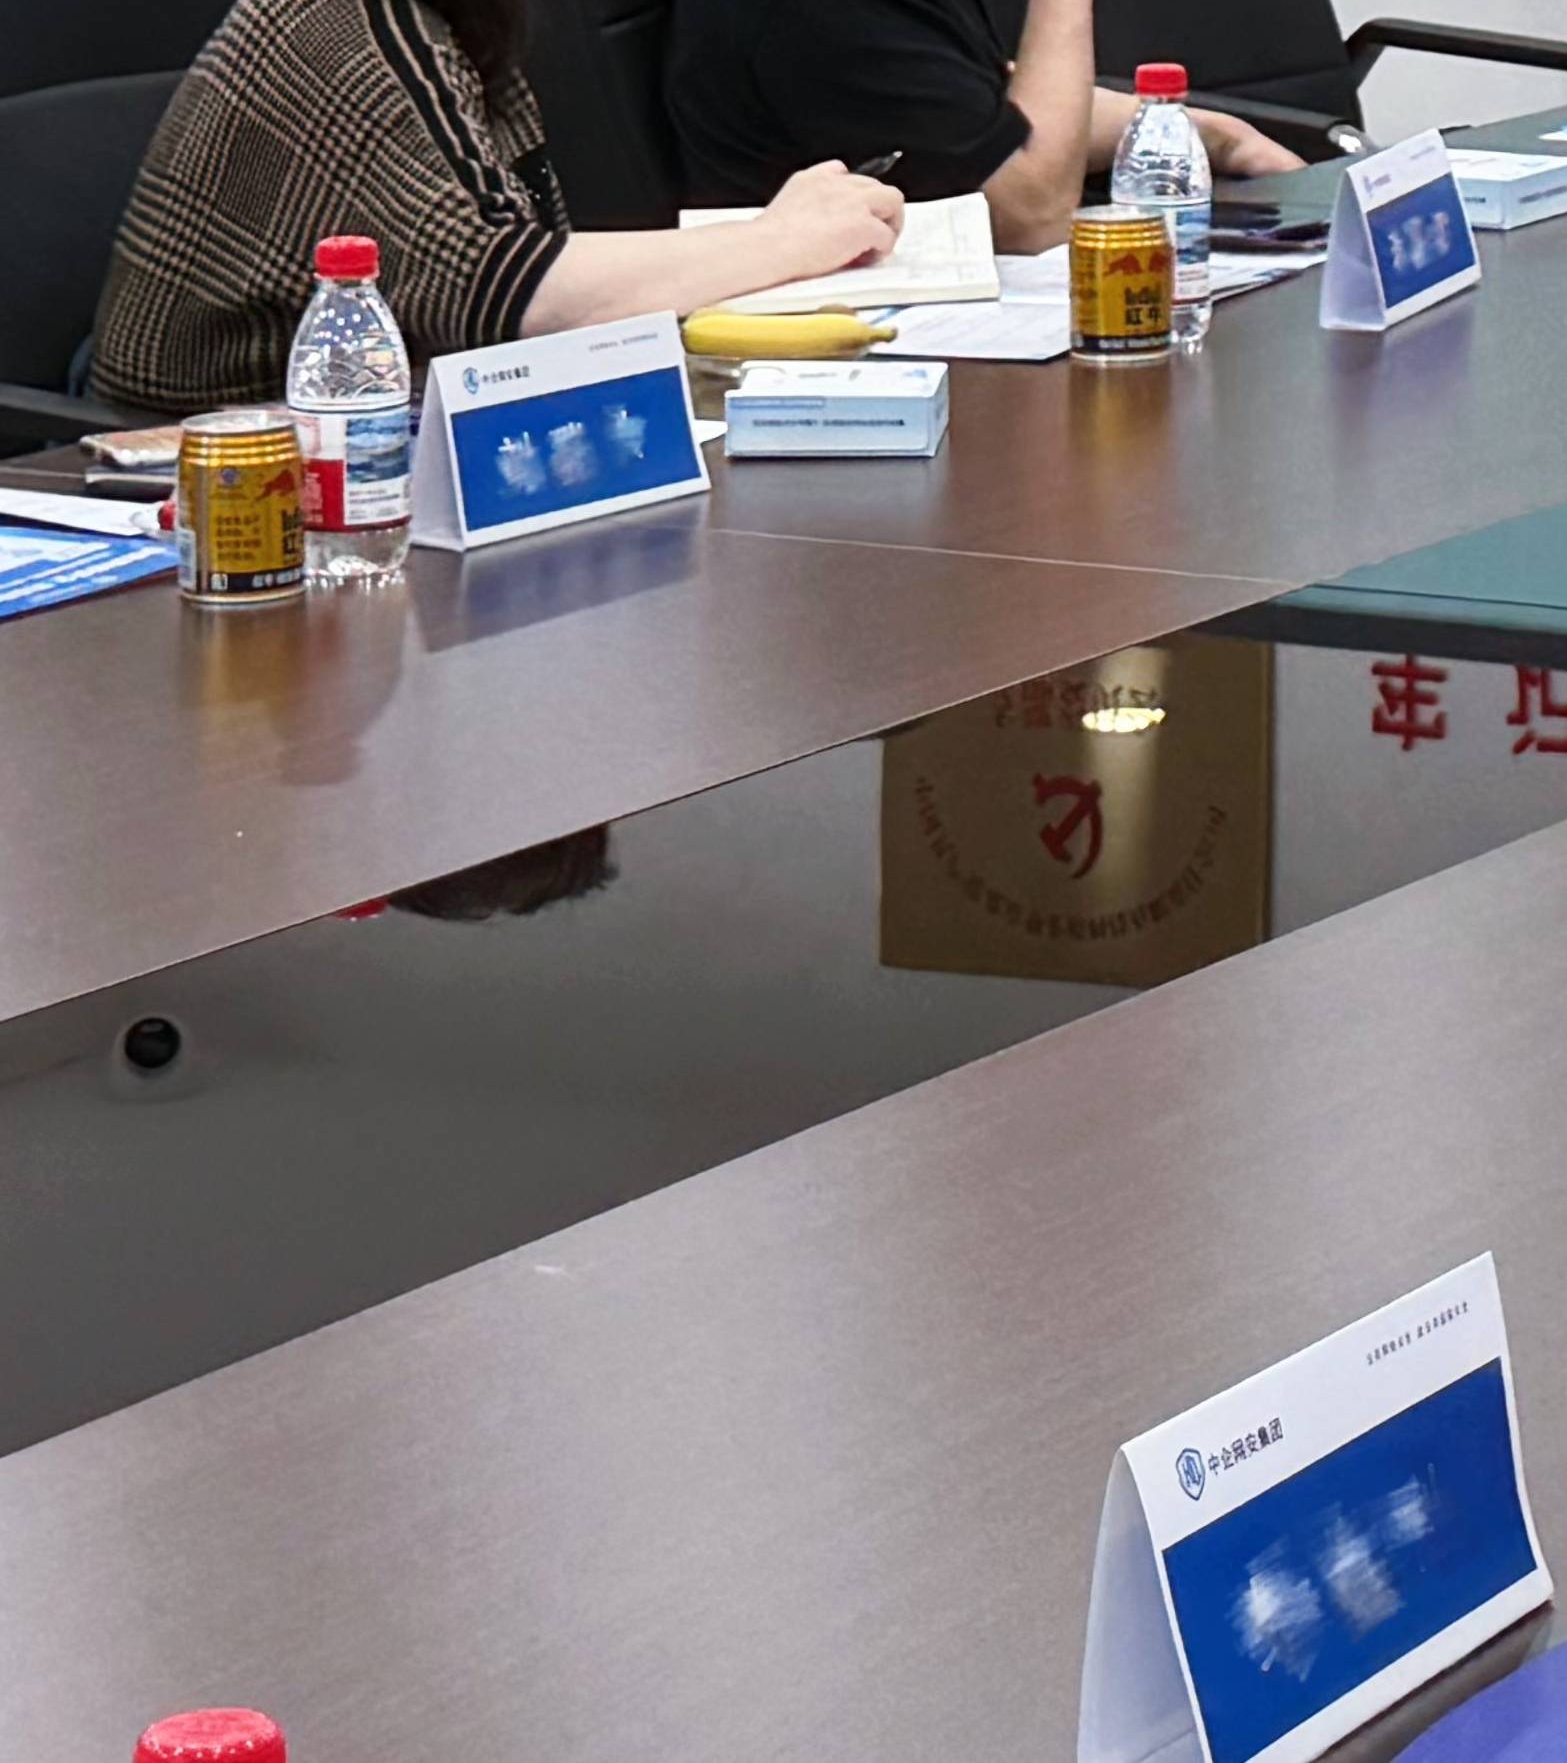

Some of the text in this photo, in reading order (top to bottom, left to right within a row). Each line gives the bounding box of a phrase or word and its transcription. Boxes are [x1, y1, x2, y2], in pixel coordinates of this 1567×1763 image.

[1207, 1416, 1284, 1477] 中企网安集团
